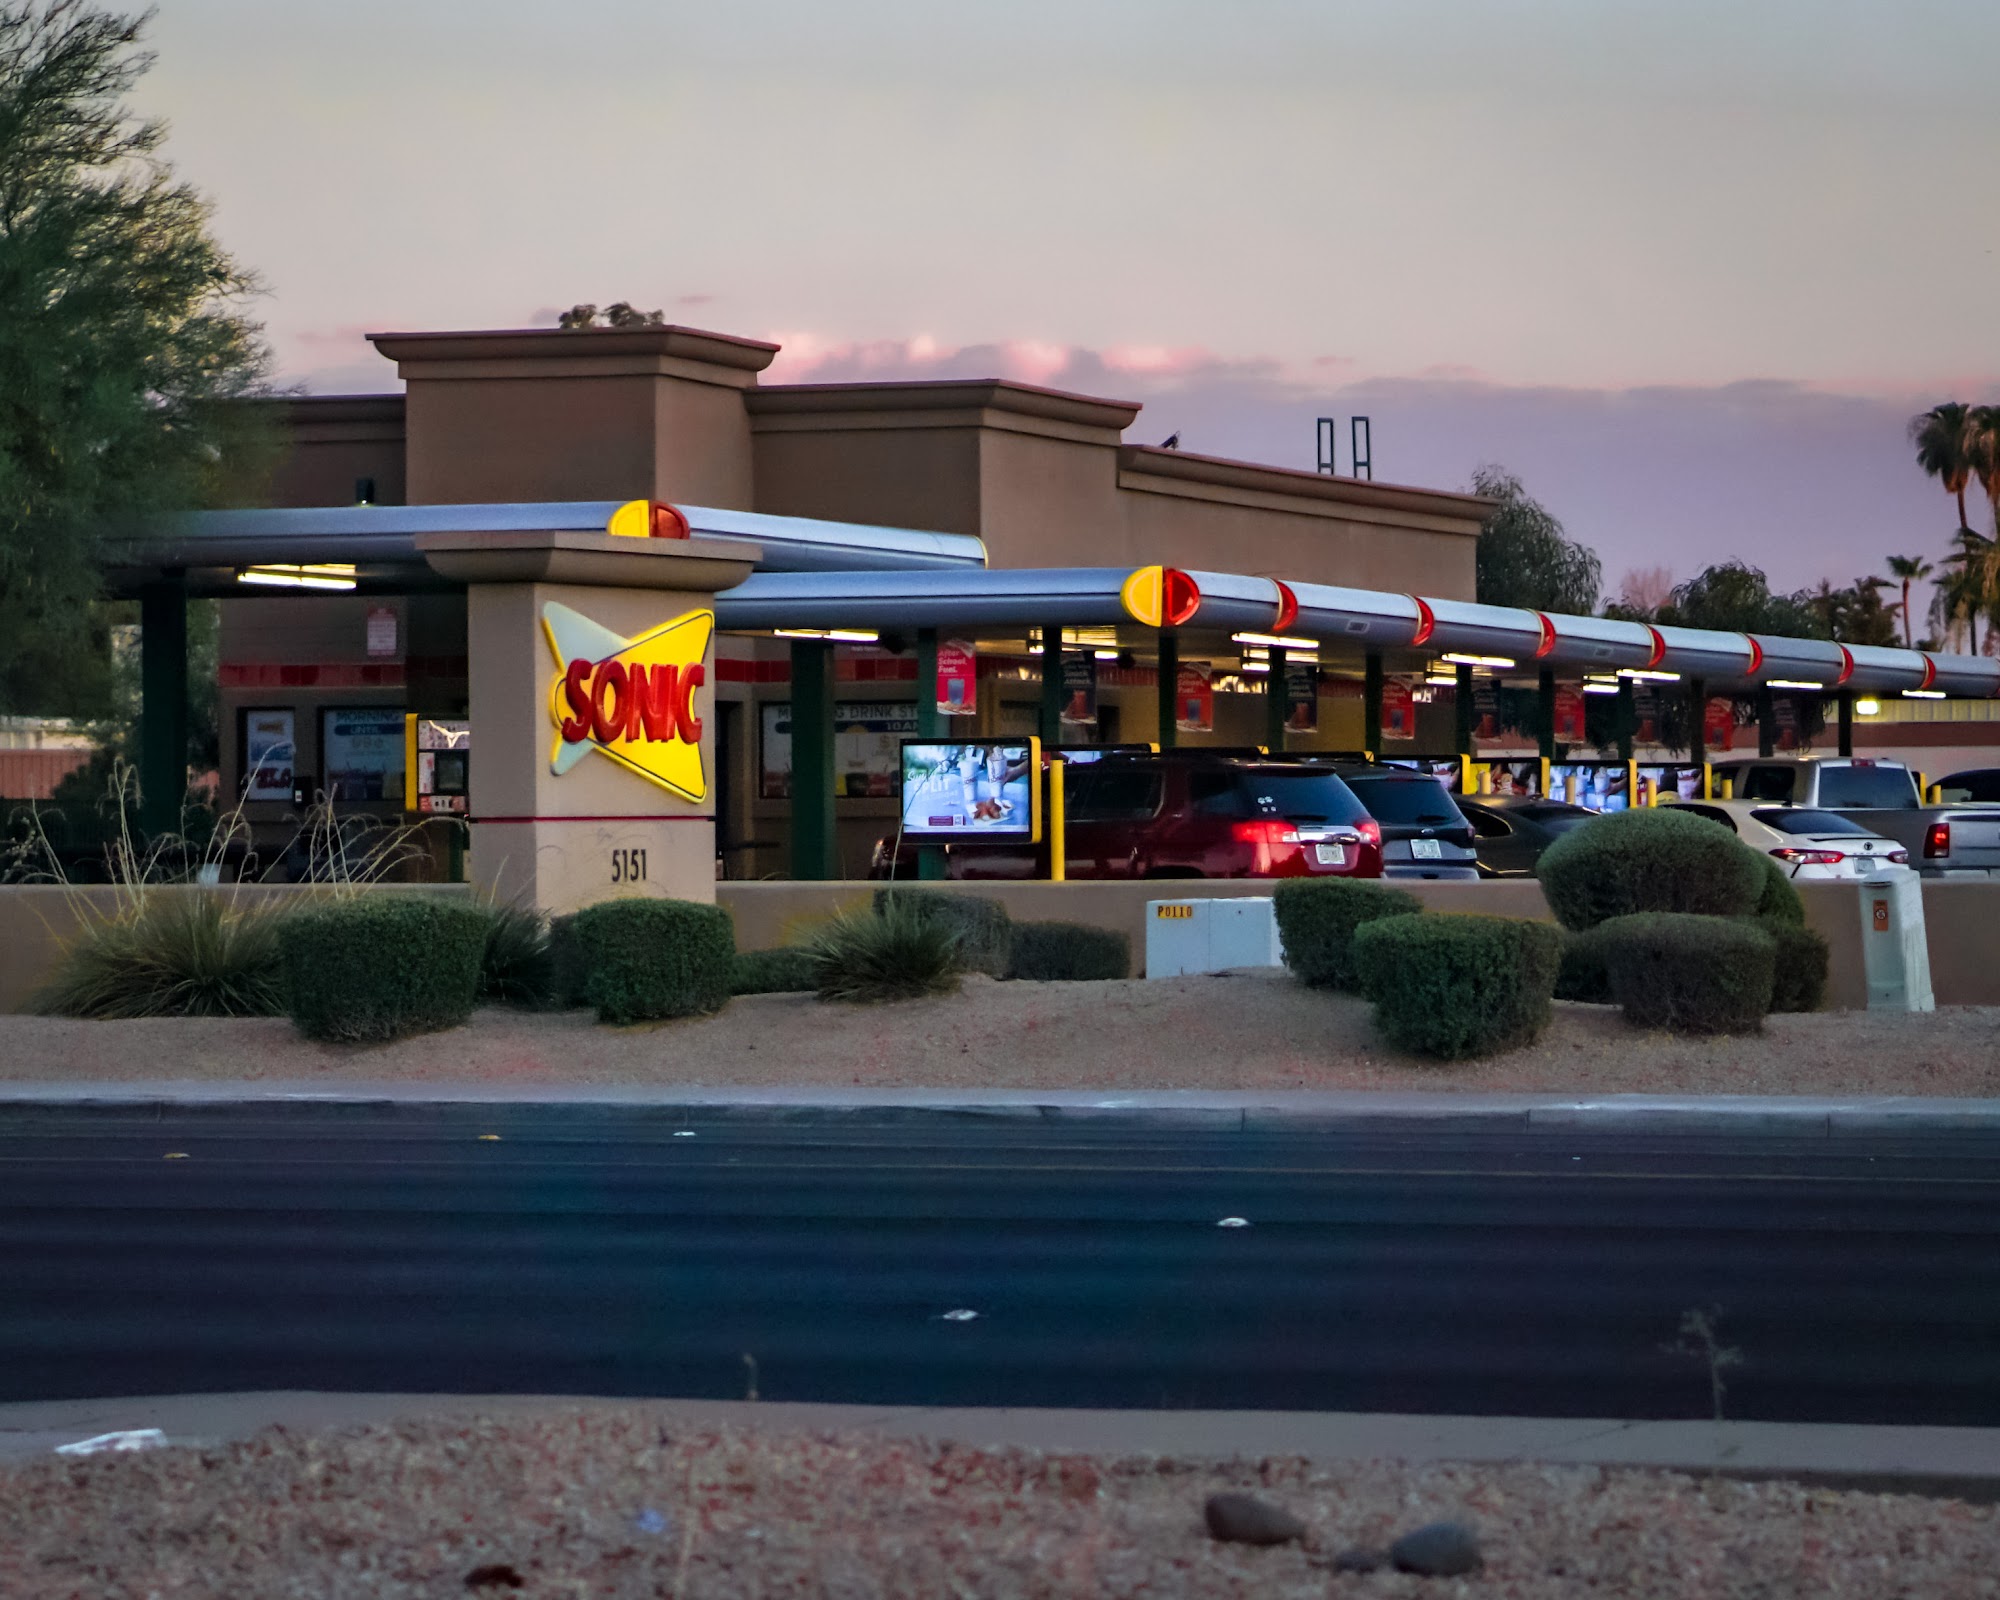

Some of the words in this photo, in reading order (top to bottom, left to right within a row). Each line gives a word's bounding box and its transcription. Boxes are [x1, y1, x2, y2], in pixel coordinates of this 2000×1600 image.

[562, 658, 704, 745] SONIC
[850, 706, 892, 718] DRINK
[612, 849, 648, 882] 5151
